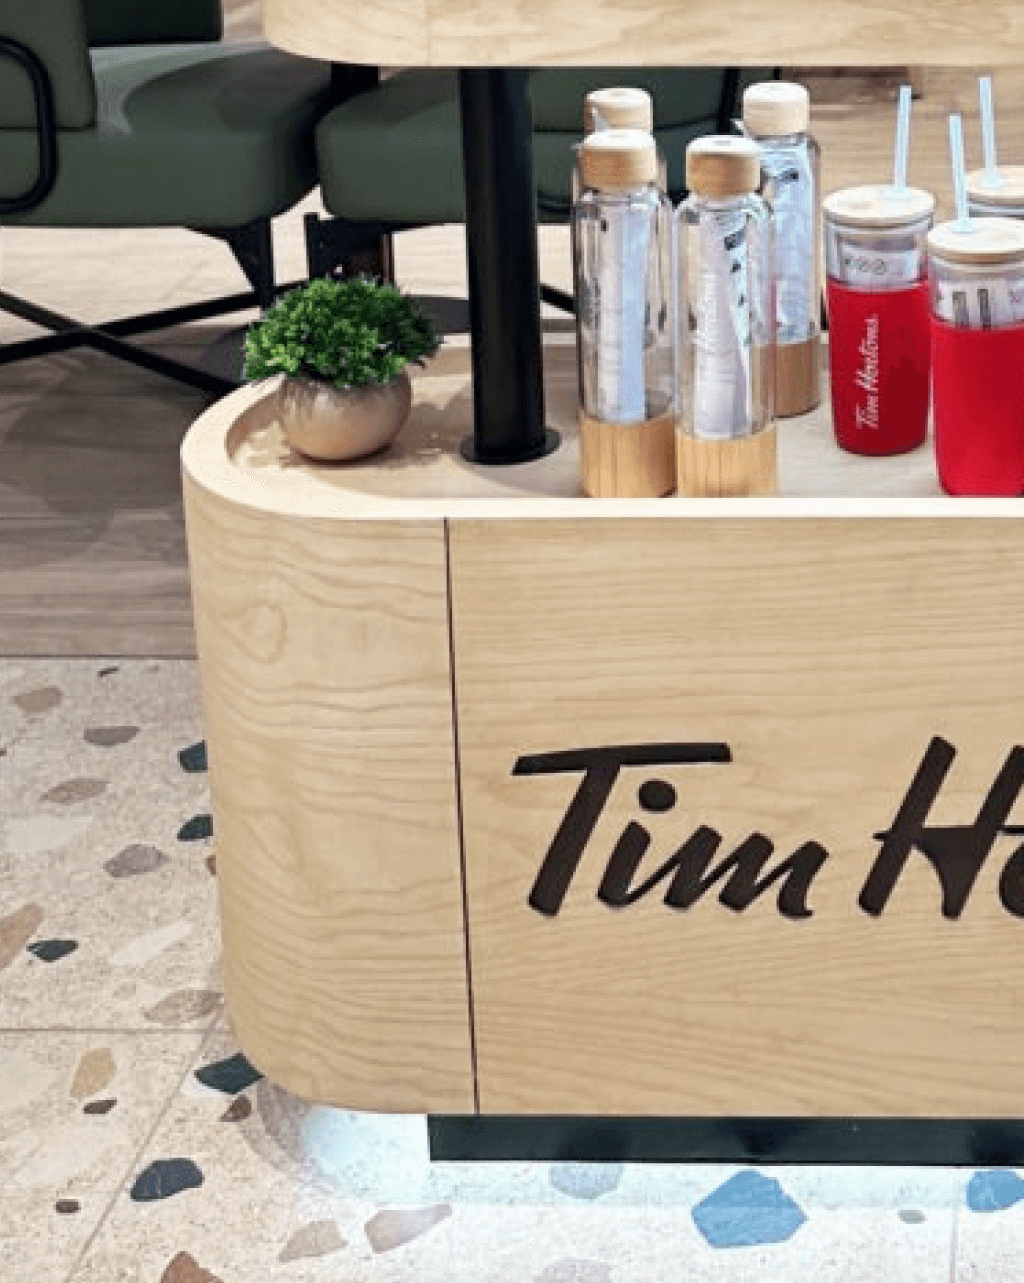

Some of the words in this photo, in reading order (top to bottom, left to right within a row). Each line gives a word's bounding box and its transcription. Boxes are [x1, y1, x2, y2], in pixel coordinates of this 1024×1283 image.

[854, 313, 879, 391] Hortons
[855, 391, 879, 429] Tim
[511, 742, 830, 920] Tim
